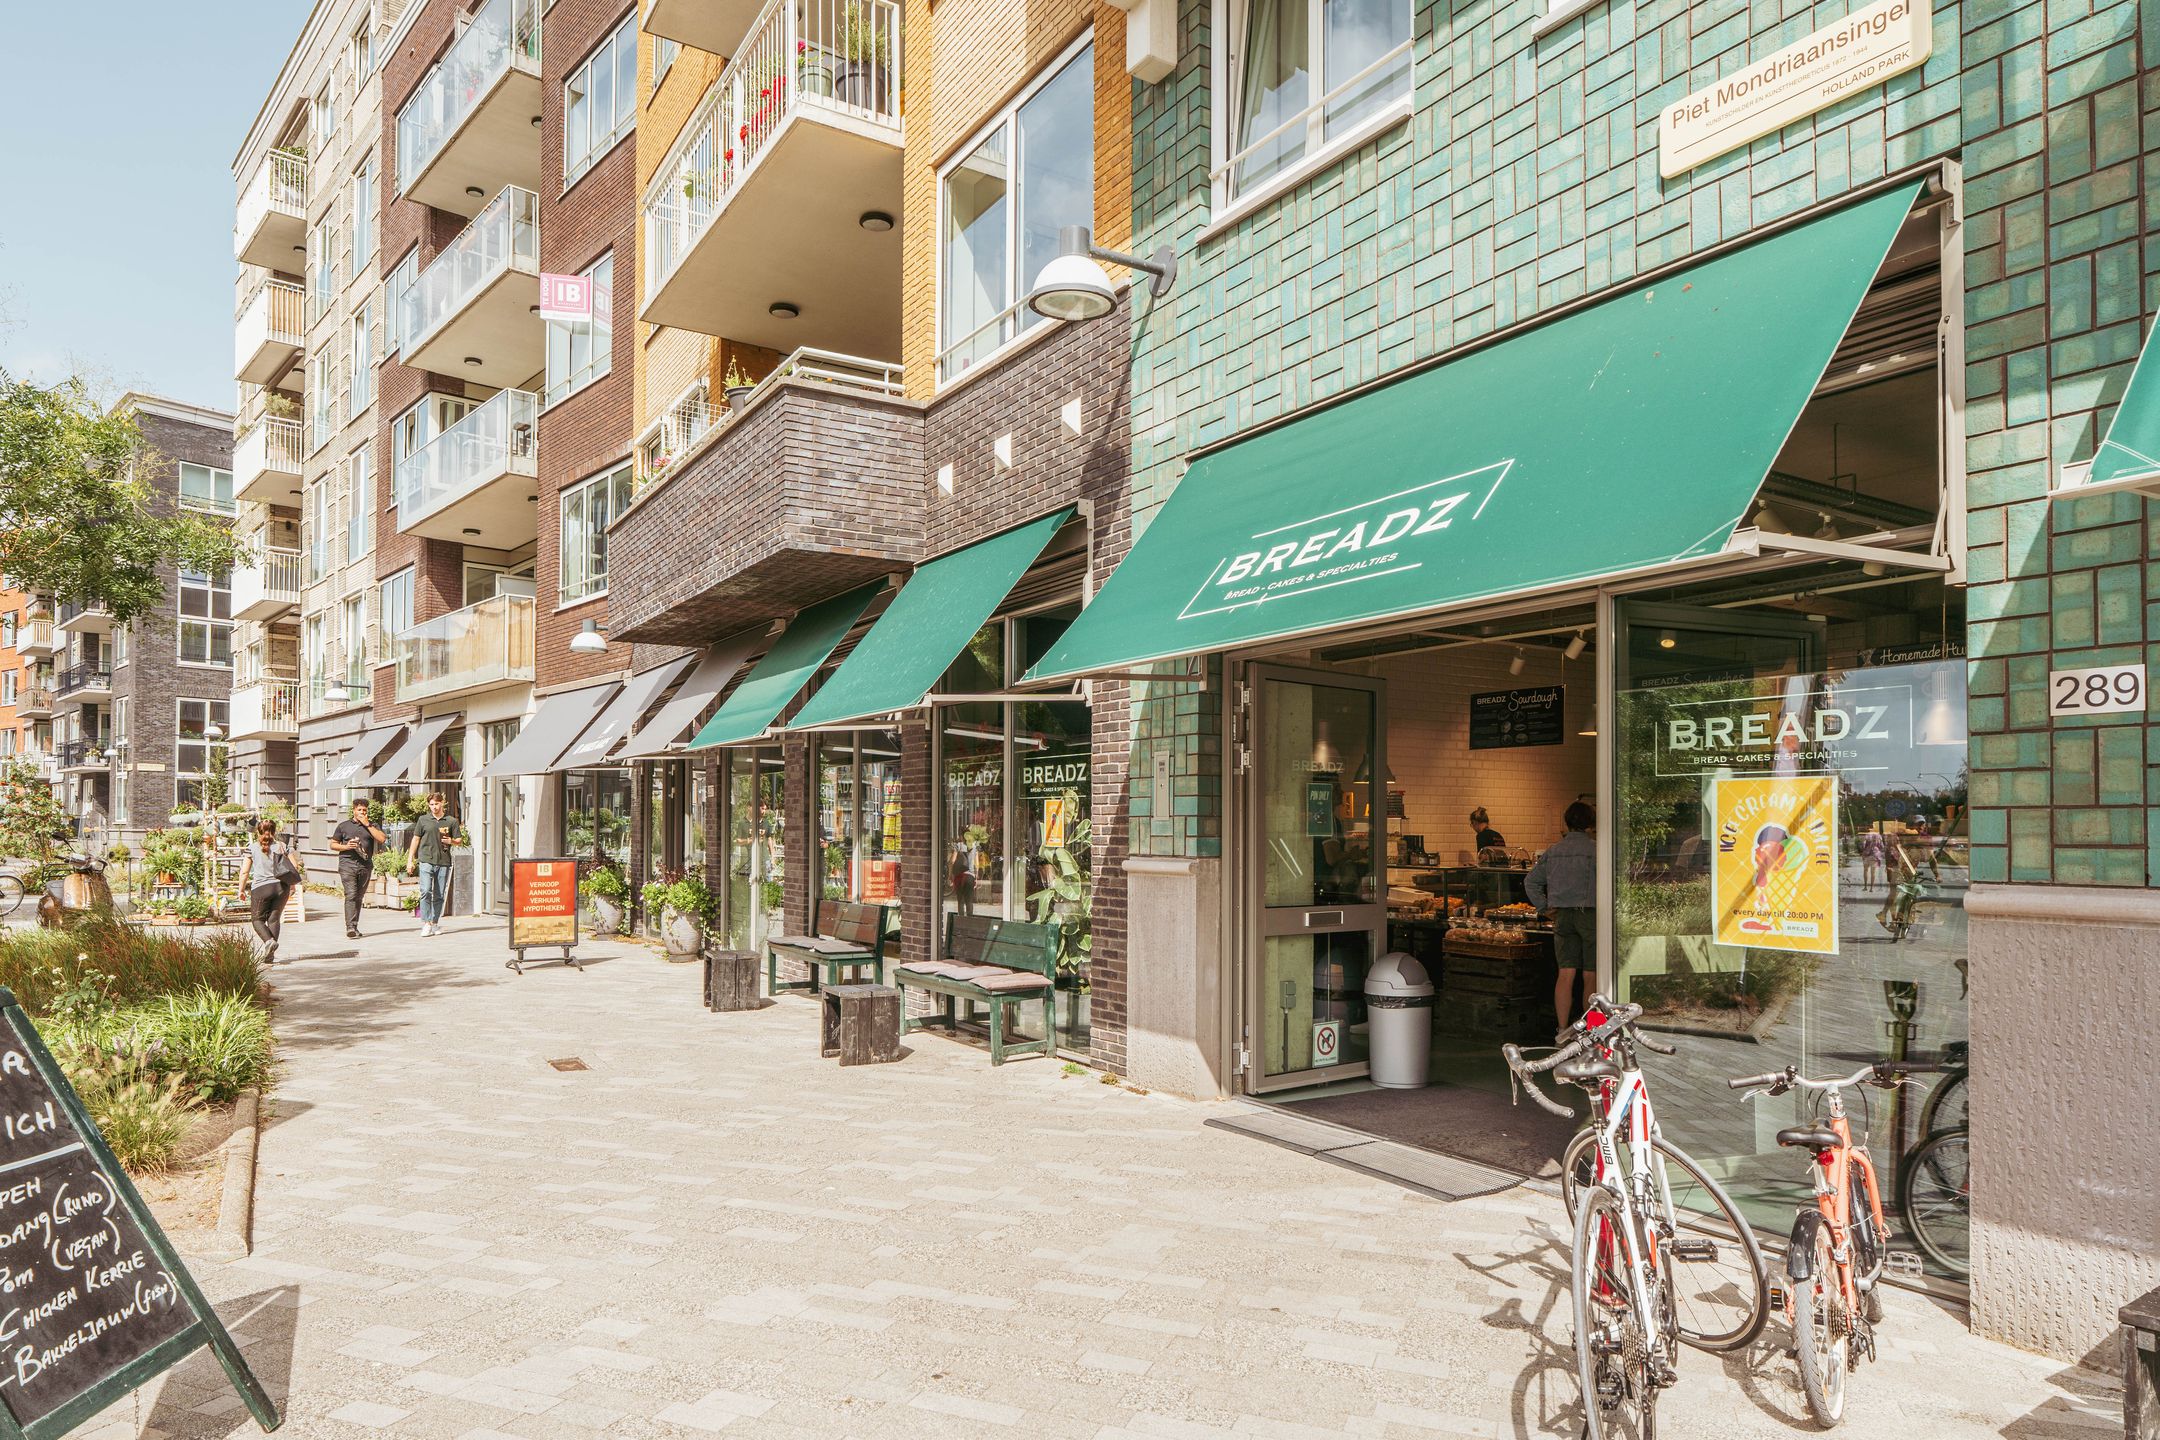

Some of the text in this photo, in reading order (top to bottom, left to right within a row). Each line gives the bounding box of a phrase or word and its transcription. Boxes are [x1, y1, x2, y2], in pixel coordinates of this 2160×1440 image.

[1672, 0, 1910, 129] Piet Mondriaansingel
[1822, 49, 1911, 97] HOLLAND PARK
[1705, 101, 1754, 127] KUNSTSCHILDER
[1754, 95, 1764, 105] EN
[1764, 64, 1831, 100] KUNSTTHEORETICUS
[557, 282, 581, 303] IB
[1215, 491, 1471, 586] BREADZ
[1224, 587, 1260, 600] BREAD
[1267, 575, 1304, 590] CAKES
[1305, 573, 1313, 581] &
[1316, 552, 1399, 579] SPECIALTIES
[1880, 644, 1941, 665] Homemade
[1641, 677, 1679, 687] BREADZ
[2056, 672, 2139, 709] 289
[1476, 688, 1558, 711] BREADZ Sourdough
[1668, 705, 1889, 750] BREADZ
[1693, 756, 1727, 764] BREAD
[1736, 754, 1771, 762] CAKES
[1784, 750, 1857, 760] SPECIALTIES
[949, 769, 1001, 788] BREADZ
[1023, 763, 1087, 784] BREADZ
[539, 864, 550, 873] IB
[1733, 909, 1823, 920] every day till 20:00 PM
[1600, 1135, 1613, 1165] BMC
